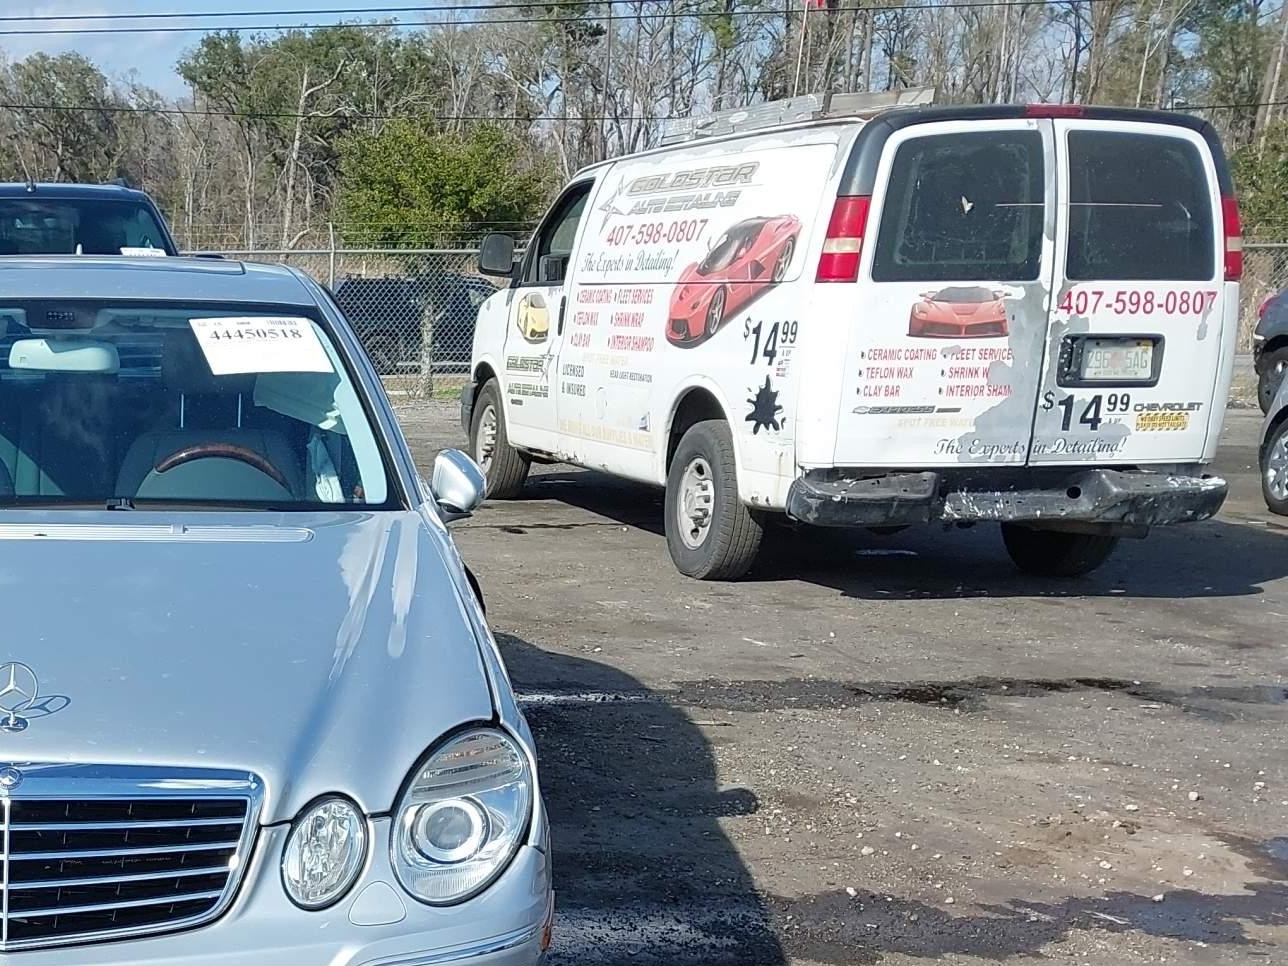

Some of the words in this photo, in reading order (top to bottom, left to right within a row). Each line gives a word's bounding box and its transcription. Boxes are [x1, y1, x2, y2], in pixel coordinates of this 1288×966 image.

[607, 218, 709, 246] 407-598-0807
[596, 251, 624, 279] Experts
[625, 253, 633, 271] in
[1057, 290, 1218, 315] 407-598-0807
[210, 328, 303, 341] 44450518
[867, 349, 902, 361] CERAMIC
[904, 349, 937, 361] COATING
[865, 367, 894, 379] TEFLON
[896, 367, 914, 379] WAX
[948, 366, 980, 379] SHRINK
[863, 385, 882, 397] CLAY
[884, 385, 901, 397] BAR
[945, 384, 985, 397] INTERIOR
[1133, 402, 1204, 412] CHEVROLET
[934, 438, 961, 455] The
[968, 438, 1026, 460] Experts
[1032, 440, 1047, 454] in
[1050, 435, 1127, 458] Detailing!
